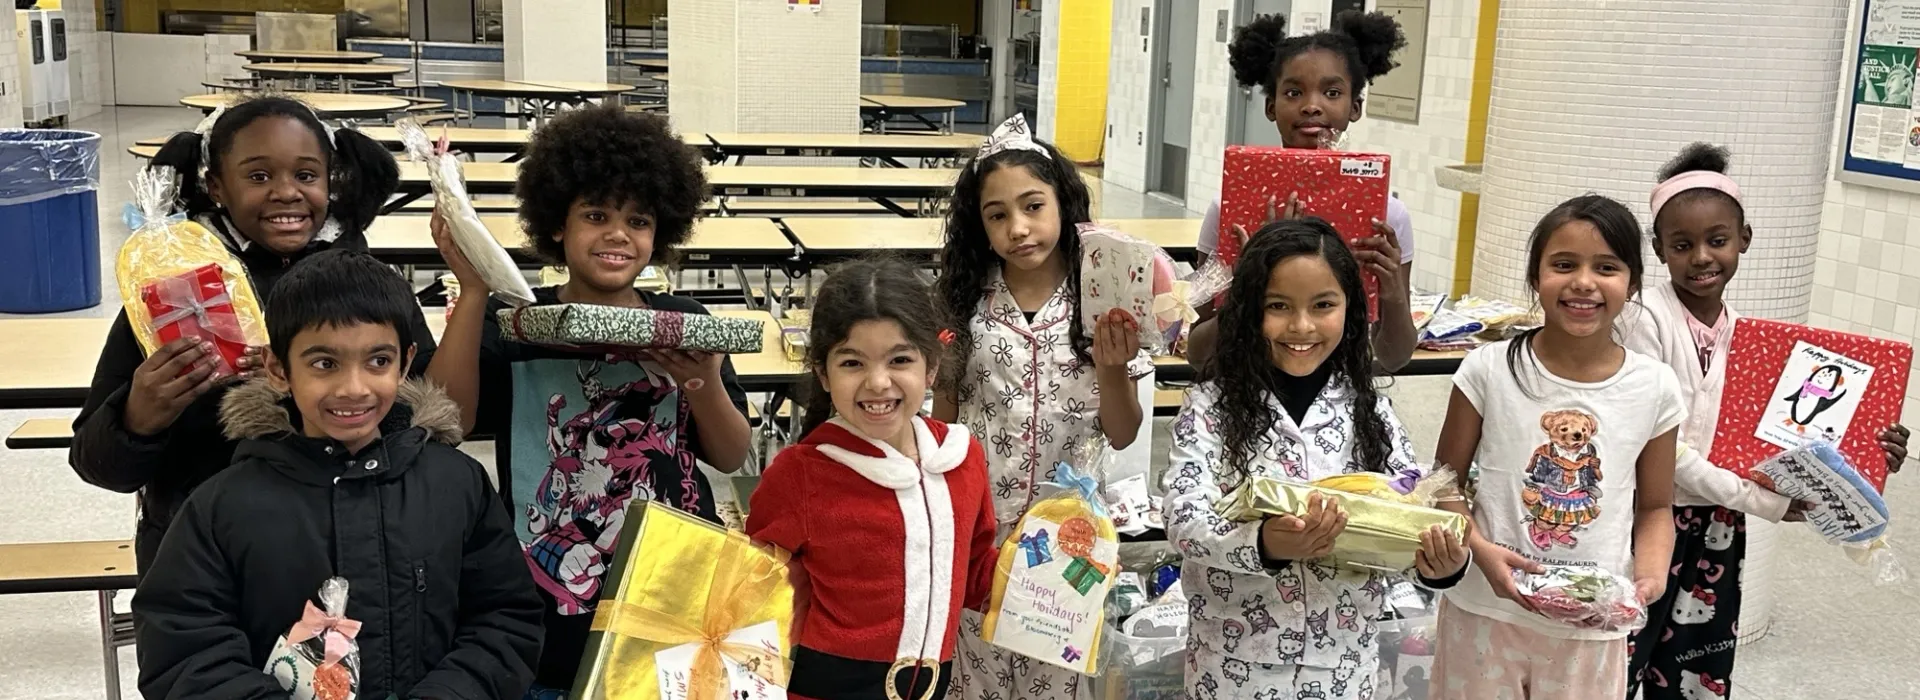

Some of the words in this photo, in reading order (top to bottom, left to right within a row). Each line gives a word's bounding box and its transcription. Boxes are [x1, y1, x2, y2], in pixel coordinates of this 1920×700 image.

[1542, 557, 1567, 566] RALPH
[1020, 577, 1056, 605] Happy
[1032, 600, 1089, 634] Holidays!
[1675, 649, 1704, 663] Hello
[1704, 639, 1735, 654] Kitty
